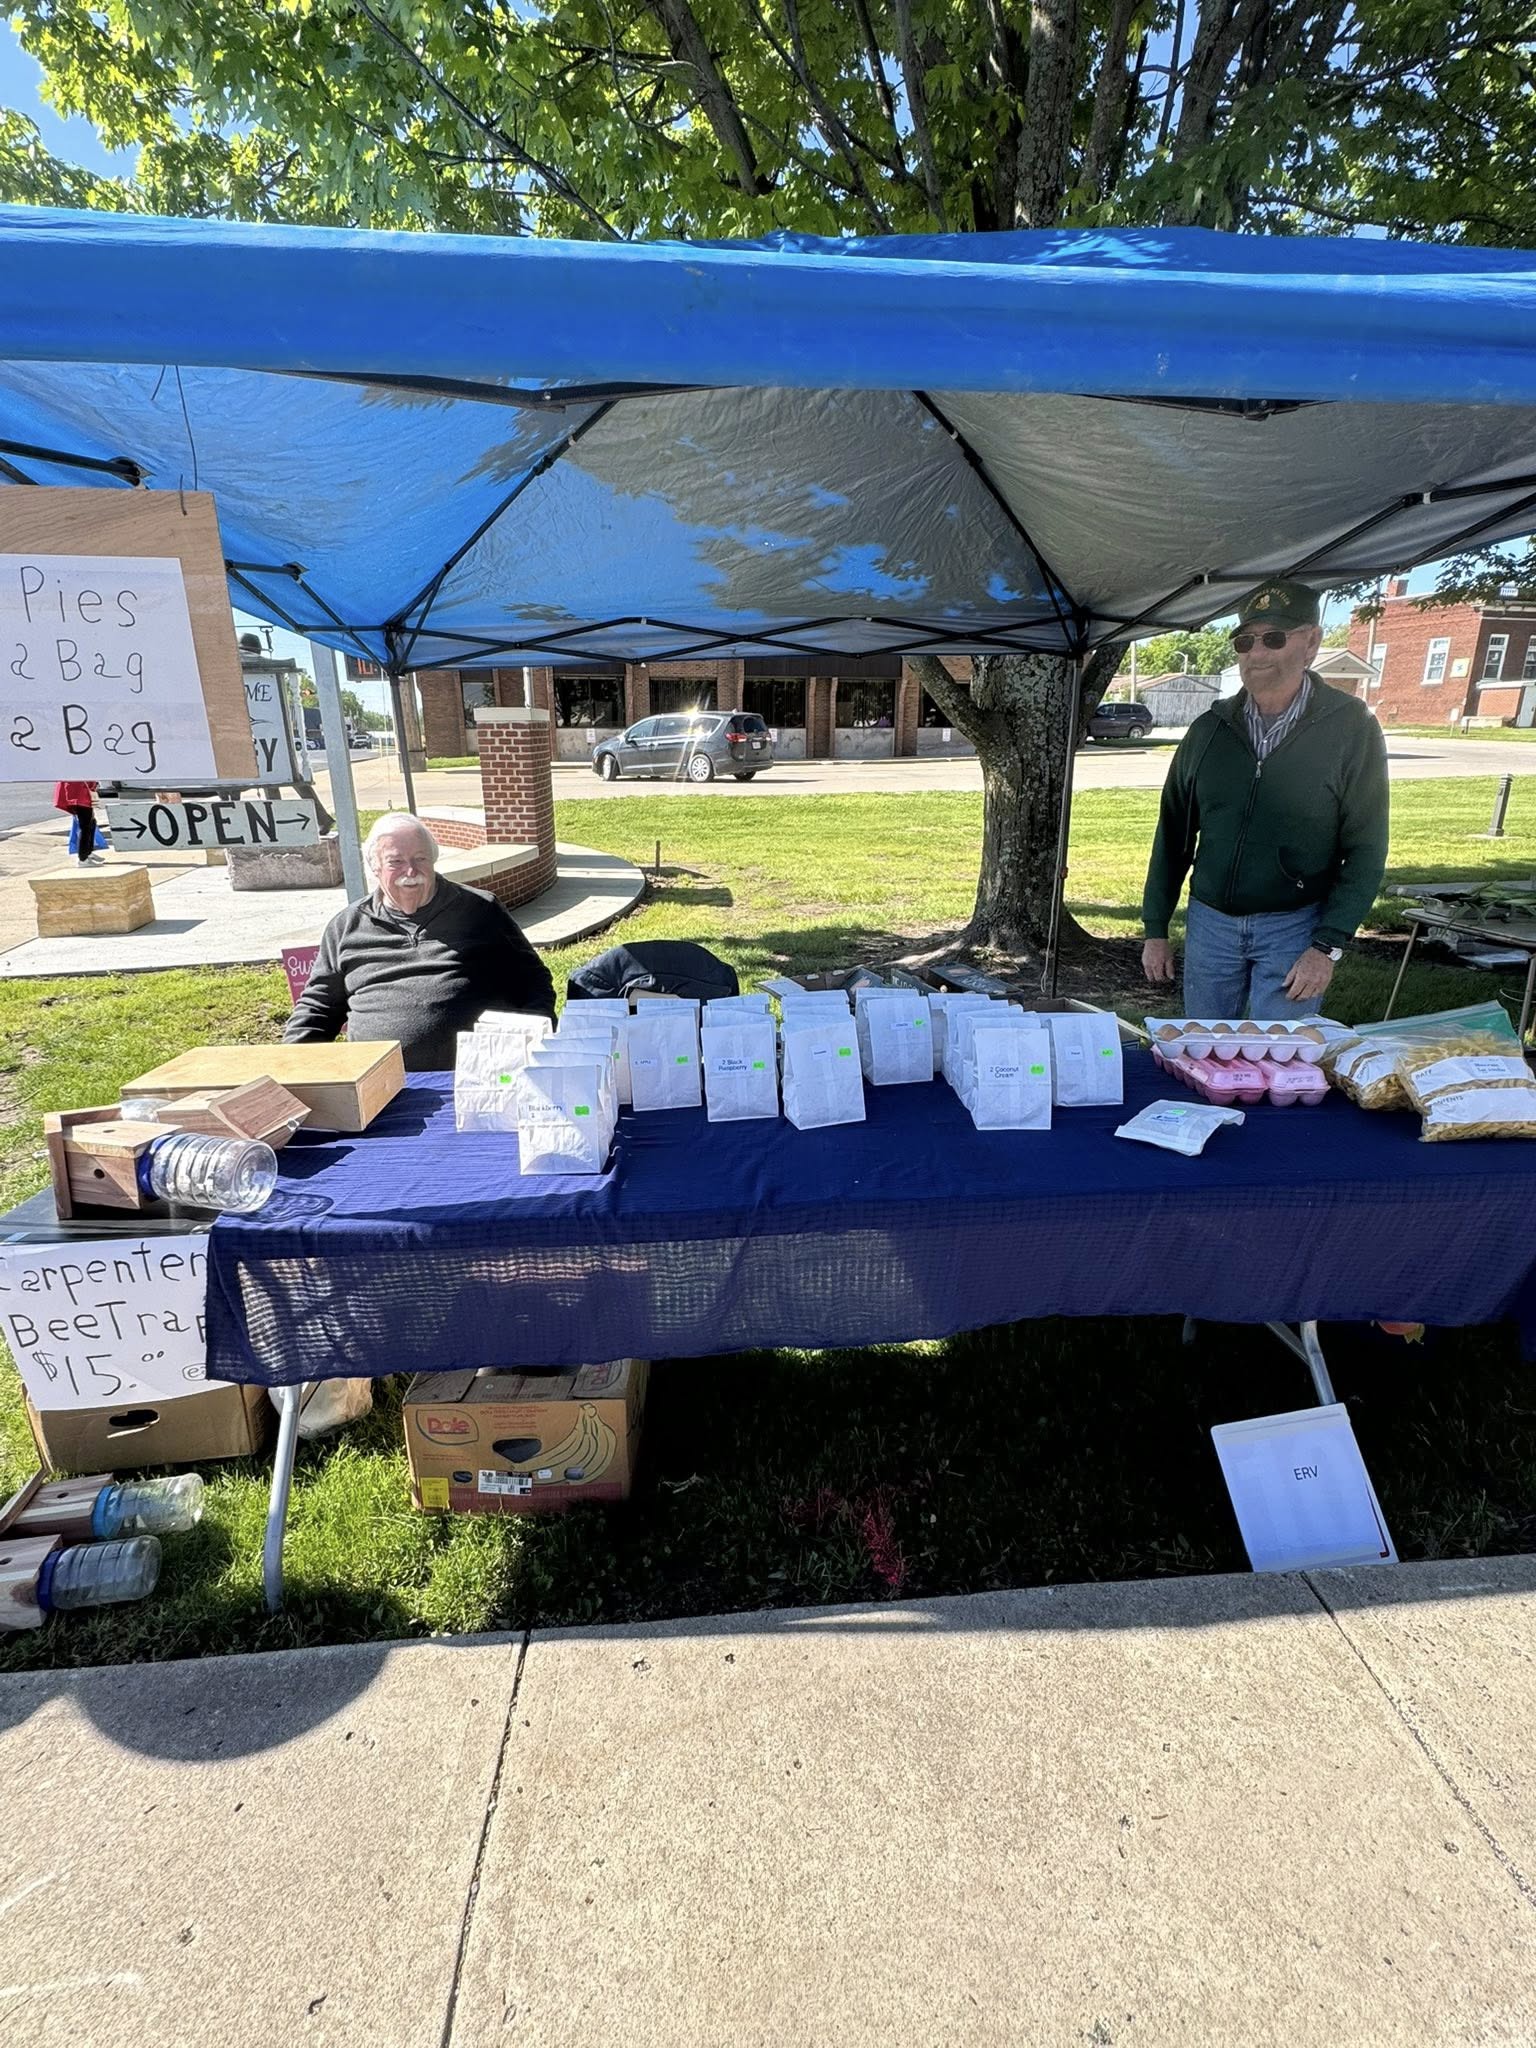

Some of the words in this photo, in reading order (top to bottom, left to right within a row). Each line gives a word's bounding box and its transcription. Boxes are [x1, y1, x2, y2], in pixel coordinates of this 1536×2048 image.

[20, 565, 138, 628] Pies
[10, 642, 35, 680] a
[56, 639, 144, 694] Bag
[10, 715, 41, 751] a
[62, 704, 156, 774] Bag
[148, 801, 279, 847] OPEN
[994, 1065, 1019, 1073] Coconut
[427, 1417, 470, 1434] Dole
[1293, 1465, 1319, 1481] ERV
